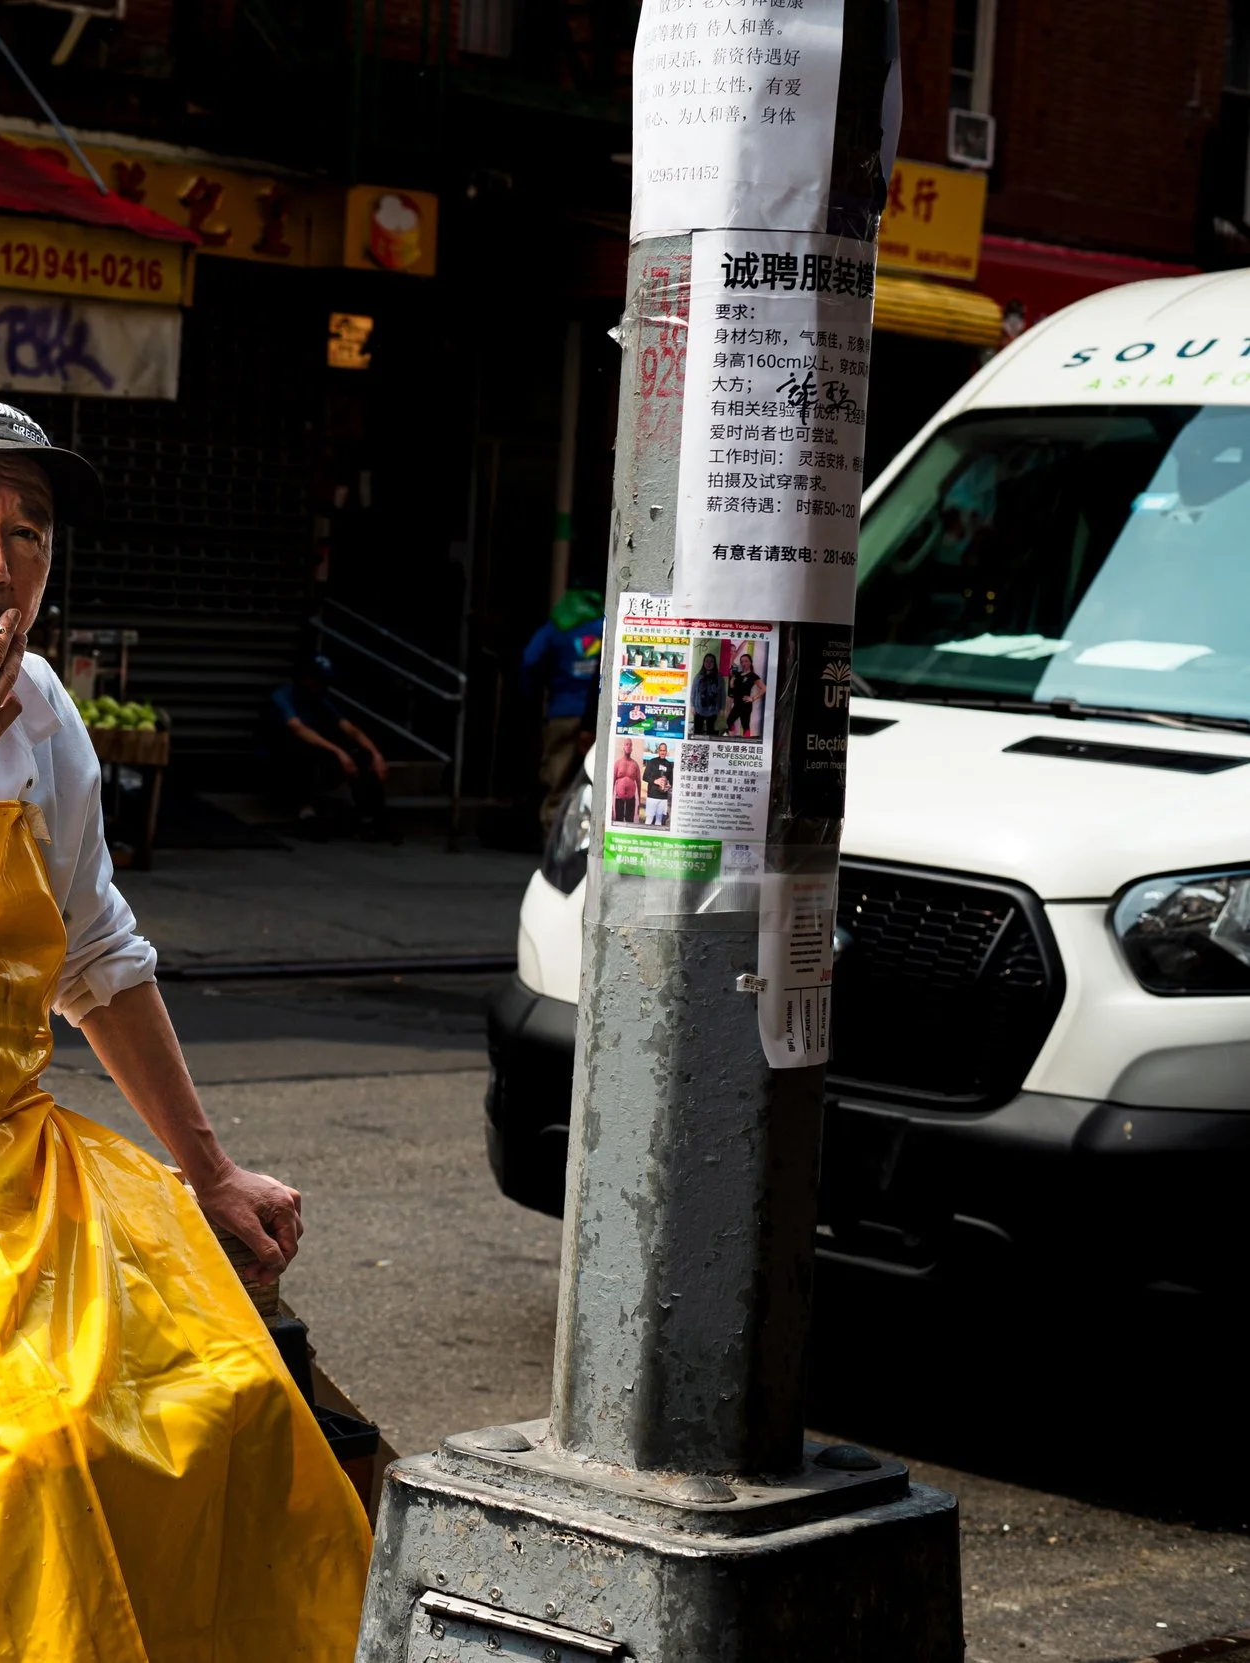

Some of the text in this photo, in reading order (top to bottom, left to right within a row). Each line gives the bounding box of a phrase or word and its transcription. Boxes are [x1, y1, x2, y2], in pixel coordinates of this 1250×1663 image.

[707, 18, 783, 37] 待人和善。
[721, 251, 874, 299] 诚聘服装模
[715, 303, 755, 320] 要求：
[1084, 373, 1174, 391] ASIA
[709, 424, 838, 445] 爱时尚者也可尝试。
[707, 472, 826, 491] 拍摄及试穿需求。
[712, 752, 763, 761] PROFESSIONAL
[728, 760, 763, 768] SERVICES
